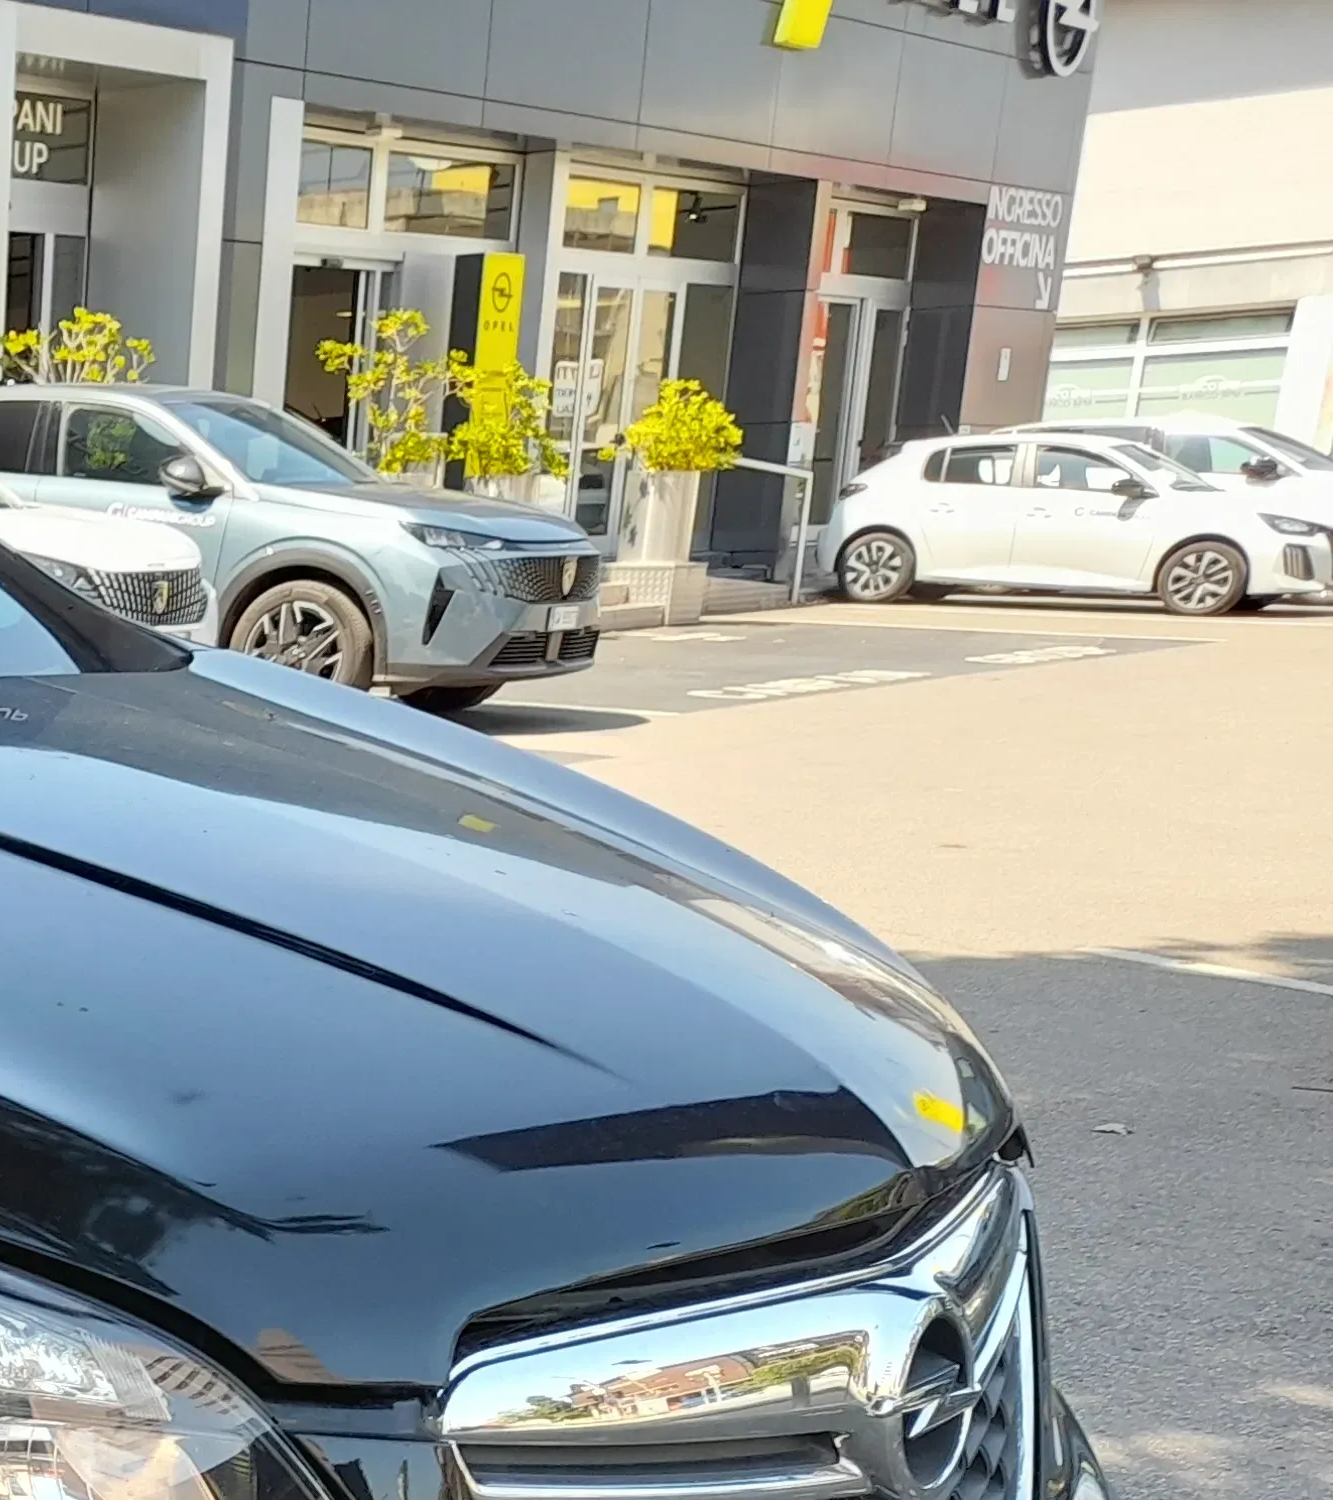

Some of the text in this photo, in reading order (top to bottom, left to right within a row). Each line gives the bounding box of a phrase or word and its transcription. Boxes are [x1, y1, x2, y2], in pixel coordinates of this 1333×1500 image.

[987, 184, 1063, 228] INGRESSO
[981, 226, 1055, 270] OFFICINA
[483, 320, 515, 333] OPEL
